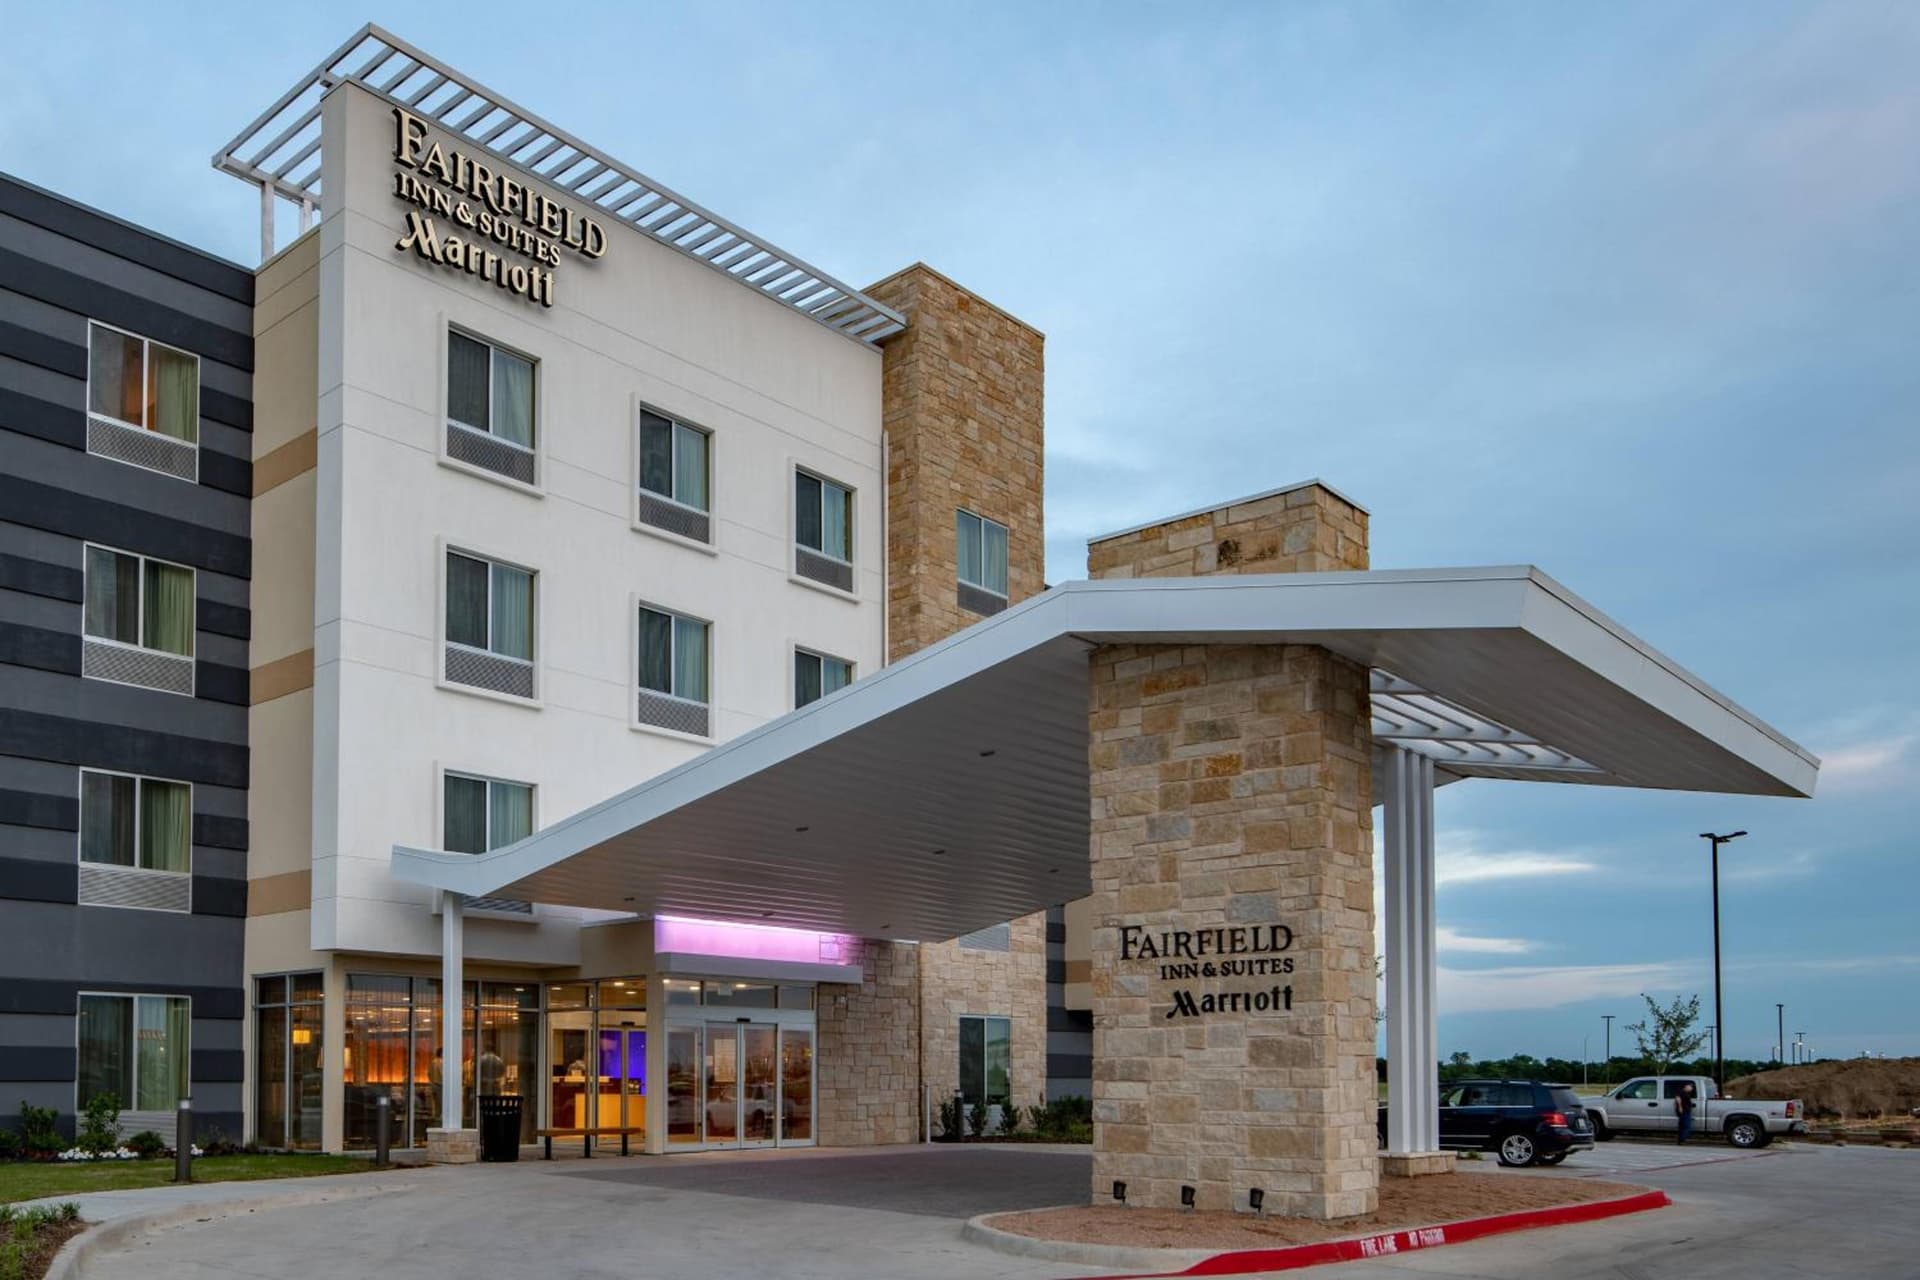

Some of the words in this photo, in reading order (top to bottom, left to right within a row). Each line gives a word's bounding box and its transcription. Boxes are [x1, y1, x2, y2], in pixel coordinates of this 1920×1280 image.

[393, 107, 608, 259] FAIRFIELD
[394, 173, 451, 217] INN
[454, 201, 478, 228] &
[478, 211, 561, 268] SUITES
[395, 210, 554, 307] Marriott
[1120, 925, 1293, 960] FAIRFIELD
[1161, 963, 1199, 980] INN
[1202, 962, 1218, 977] &
[1220, 958, 1294, 977] SUITES
[1166, 985, 1293, 1019] Marriott
